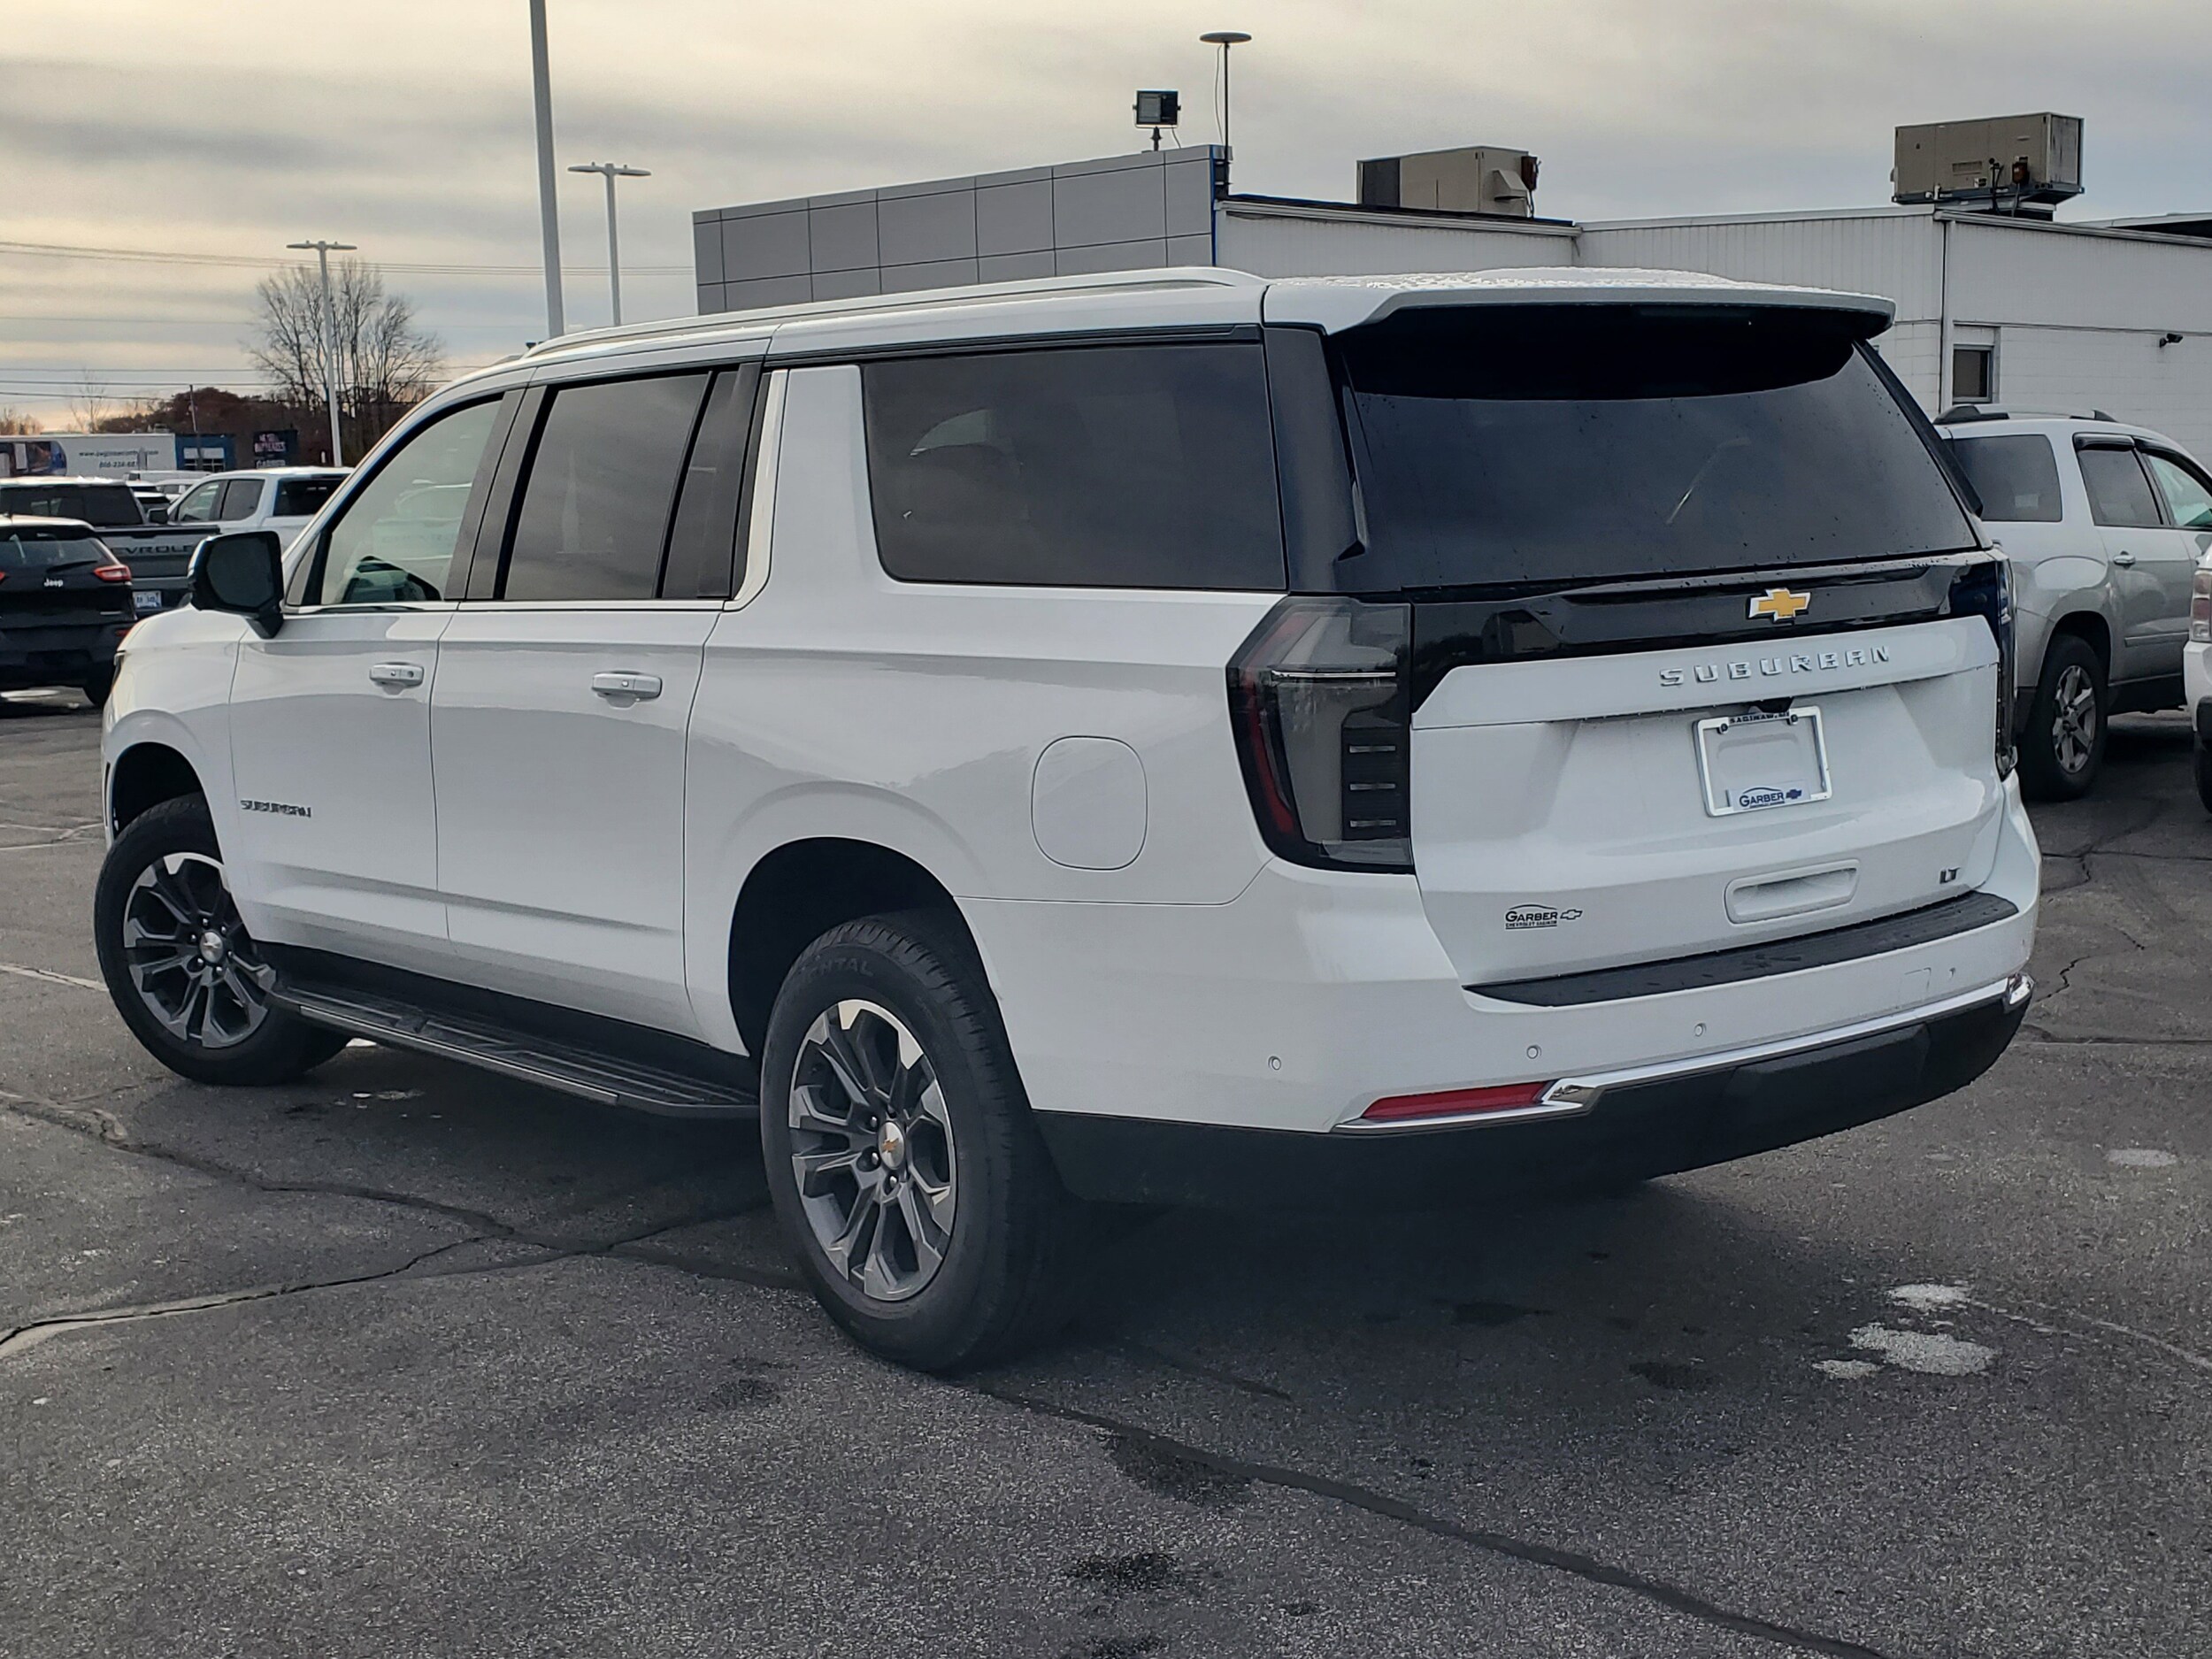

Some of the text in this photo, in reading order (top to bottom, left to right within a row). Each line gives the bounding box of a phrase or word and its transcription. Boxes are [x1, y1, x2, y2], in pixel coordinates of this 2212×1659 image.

[43, 578, 64, 588] Jeep
[1660, 646, 1889, 686] SUBURBAN
[1739, 792, 1785, 807] GARBER
[240, 800, 311, 818] SUBURBAN
[1939, 867, 1961, 884] LT
[1505, 910, 1558, 922] GARBER
